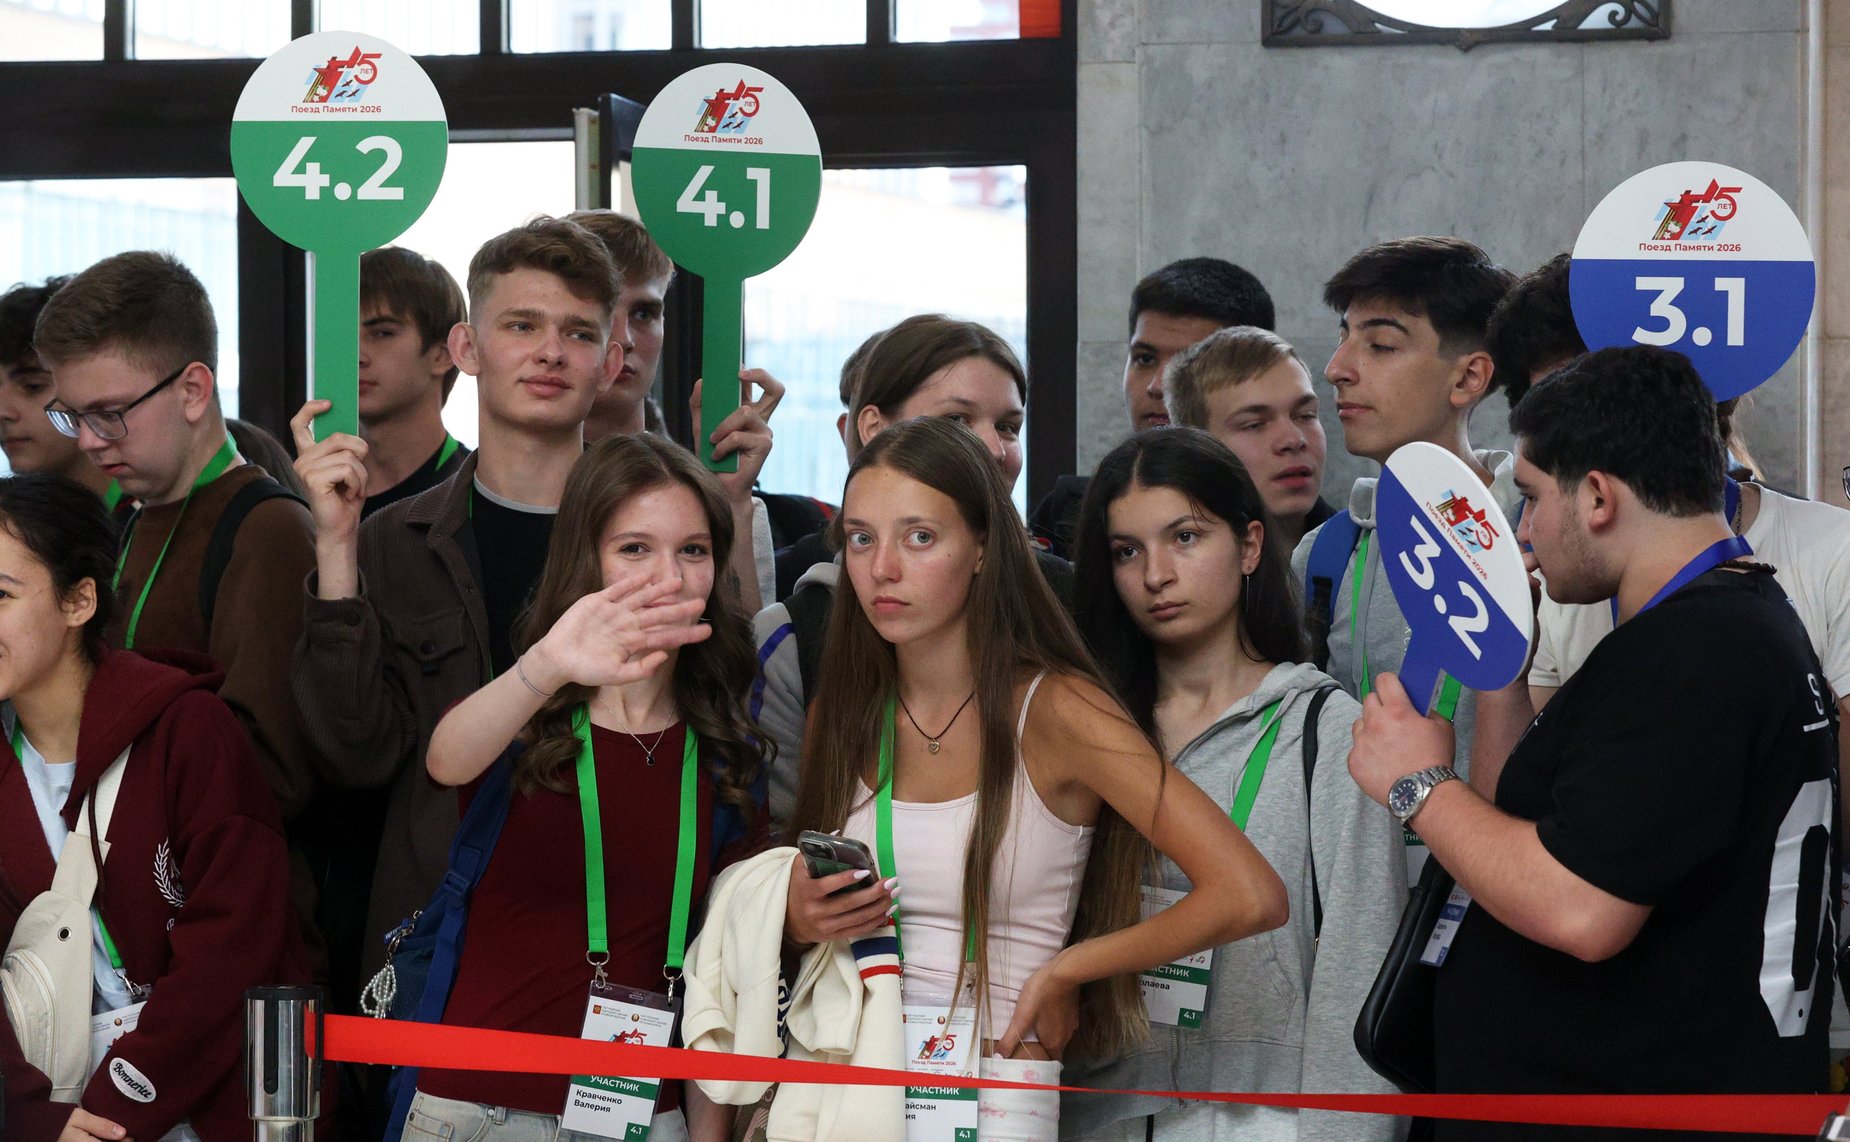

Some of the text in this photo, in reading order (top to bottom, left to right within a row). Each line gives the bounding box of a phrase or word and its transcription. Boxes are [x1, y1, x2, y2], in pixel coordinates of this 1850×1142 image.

[684, 135, 763, 145] Поезд Памяти 2026
[273, 135, 404, 200] 4.2
[677, 165, 771, 230] 4.1
[1639, 243, 1741, 252] Поезд Памяти 2026
[1632, 277, 1745, 347] 3.1
[1426, 501, 1446, 529] Поезд
[1398, 514, 1489, 661] 3.2
[1151, 965, 1190, 977] АСТНИК
[1140, 979, 1170, 990] олаева
[1183, 1011, 1196, 1020] 4.1
[590, 1075, 640, 1092] УЧАСТНИК
[910, 1086, 960, 1095] УЧАСТНИК
[576, 1089, 623, 1105] Кравченко
[574, 1099, 611, 1113] Валерия
[905, 1102, 936, 1111] айсман
[630, 1126, 643, 1135] 4.1
[959, 1131, 971, 1139] 4.1
